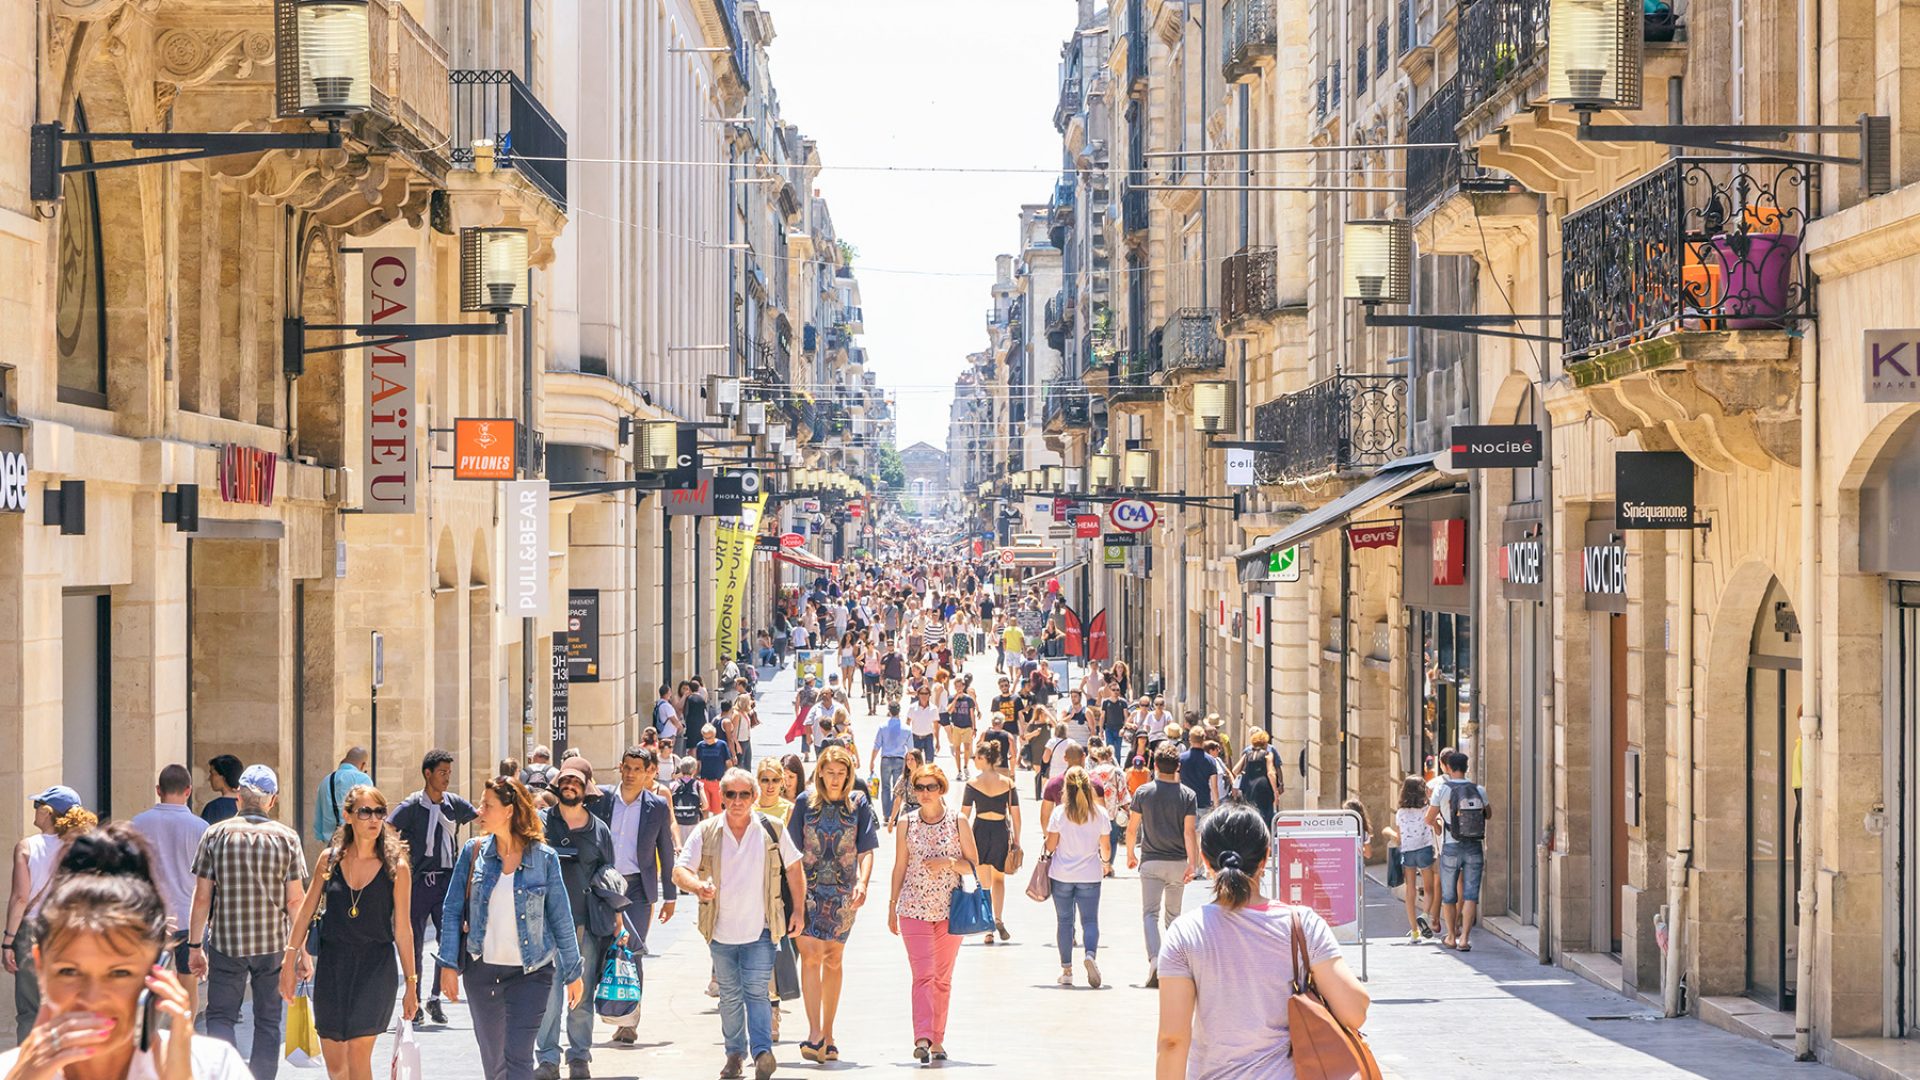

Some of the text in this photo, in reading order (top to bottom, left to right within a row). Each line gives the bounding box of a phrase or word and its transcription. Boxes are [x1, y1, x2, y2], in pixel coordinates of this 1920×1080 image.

[460, 455, 511, 470] PYLONES
[1117, 503, 1149, 522] C&A
[1622, 501, 1687, 523] Sinéquanone
[1077, 521, 1099, 529] HEMA
[519, 489, 537, 609] PULL&BEAR
